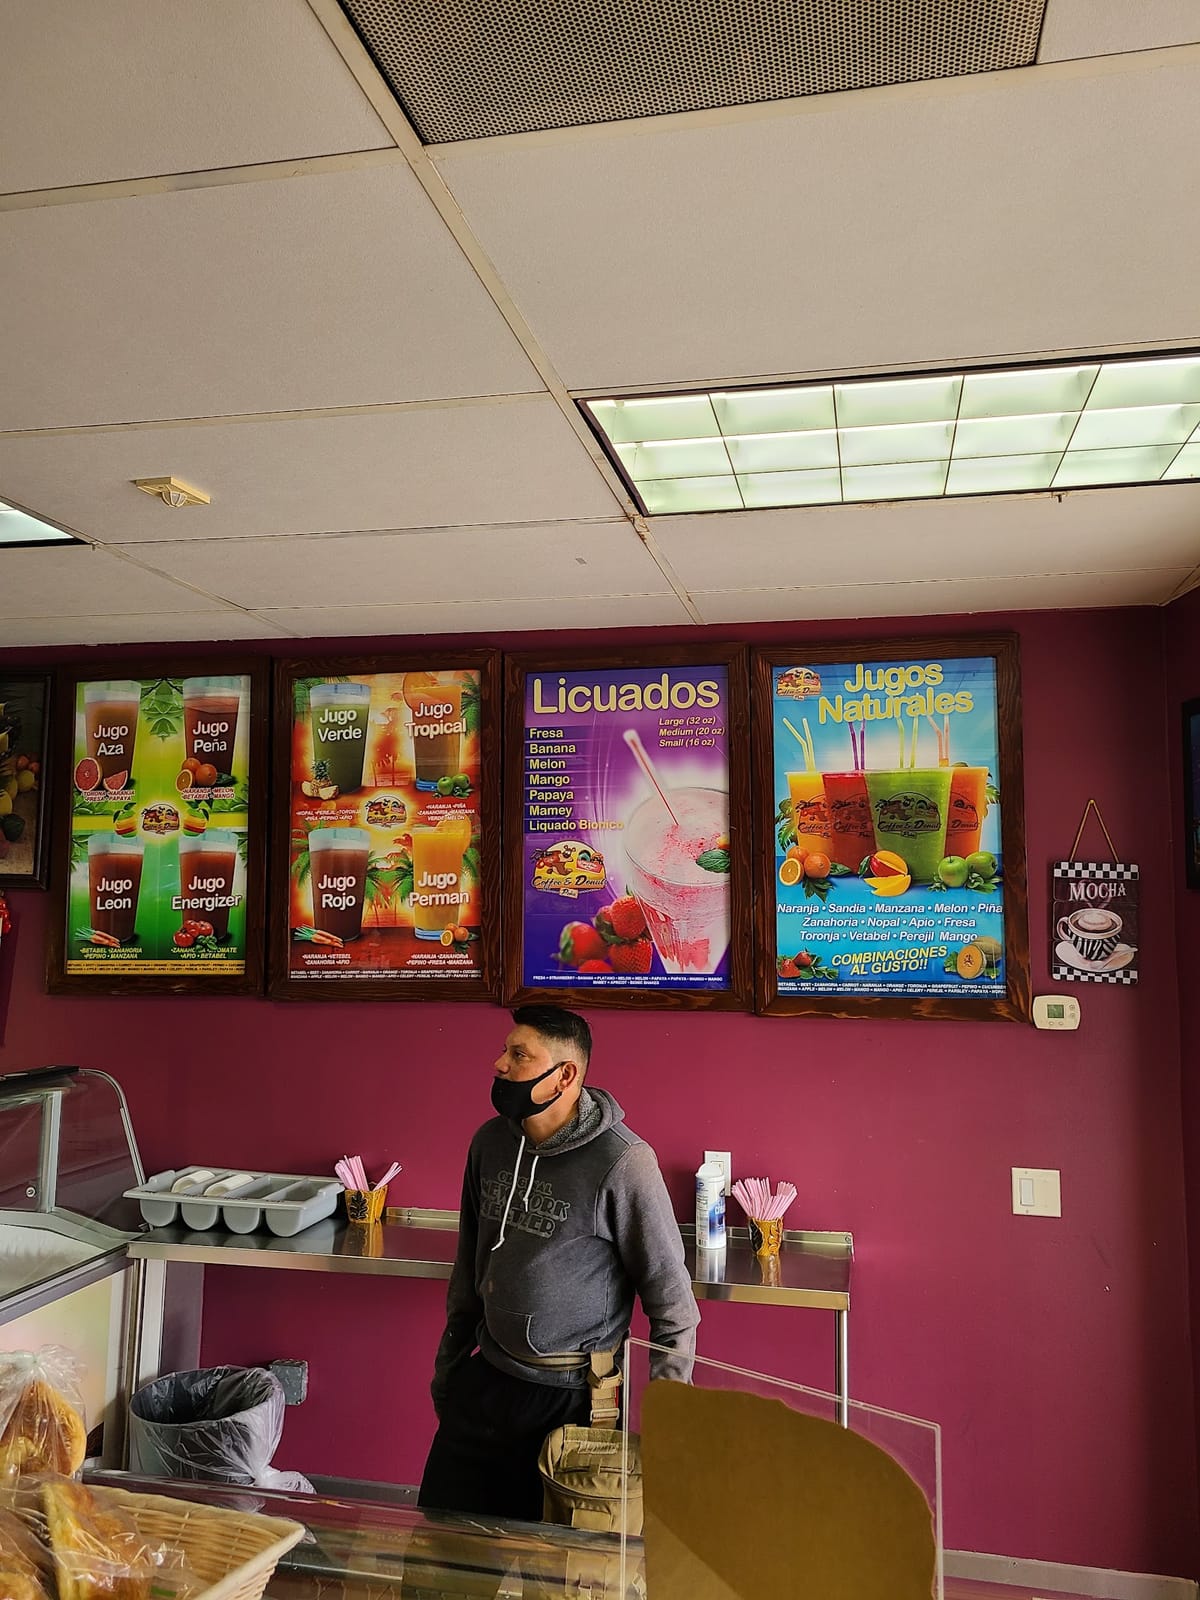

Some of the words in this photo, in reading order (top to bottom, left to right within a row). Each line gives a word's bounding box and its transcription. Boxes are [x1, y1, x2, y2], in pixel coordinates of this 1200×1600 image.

[844, 663, 944, 696] Jugos
[533, 672, 721, 714] Licuados
[415, 702, 453, 718] Jugo
[819, 687, 975, 725] Naturales
[319, 708, 357, 725] Jugo
[659, 717, 685, 727] Large
[686, 716, 701, 725] (32
[702, 716, 716, 725] oz)
[93, 724, 129, 740] Jugo
[192, 720, 229, 737] Jugo
[317, 726, 362, 742] Verde
[405, 718, 467, 739] Tropical
[529, 728, 564, 739] Fresa
[659, 727, 694, 736] Medium
[695, 727, 710, 736] (20
[711, 727, 725, 736] oz)
[97, 742, 124, 756] Aza
[193, 738, 227, 754] Peña
[529, 743, 576, 754] Banana
[659, 739, 684, 747] Small
[685, 738, 700, 747] (16
[701, 738, 715, 747] oz)
[529, 759, 566, 769] Melon
[529, 774, 570, 786] Mango
[529, 789, 574, 802] Papaya
[529, 805, 573, 817] Mamey
[529, 820, 577, 832] Liquado
[579, 819, 624, 830] Bionico
[96, 877, 133, 894] Jugo
[188, 875, 226, 893] Jugo
[318, 874, 357, 892] Jugo
[417, 871, 458, 889] Jugo
[532, 876, 562, 889] Coffee
[409, 891, 469, 907] Perman
[1069, 882, 1127, 902] MOCHA
[96, 896, 132, 910] Leon
[172, 894, 242, 912] Energizer
[321, 893, 356, 911] Rojo
[777, 903, 820, 915] Naranja
[828, 903, 866, 913] Sandia
[875, 903, 925, 913] Manzana
[934, 903, 968, 913] Melon
[977, 903, 1003, 913] Piña
[802, 917, 858, 927] Zanahoria
[867, 917, 900, 928] Nopal
[908, 917, 935, 929] Apio
[944, 917, 976, 927] Fresa
[800, 930, 840, 943] Toronja
[849, 931, 890, 941] Vetabel
[899, 931, 935, 943] Perejil
[939, 931, 978, 943] Mango
[831, 945, 948, 966] COMBINACIONES
[850, 964, 868, 976] AL
[871, 959, 928, 974] GUSTO!!
